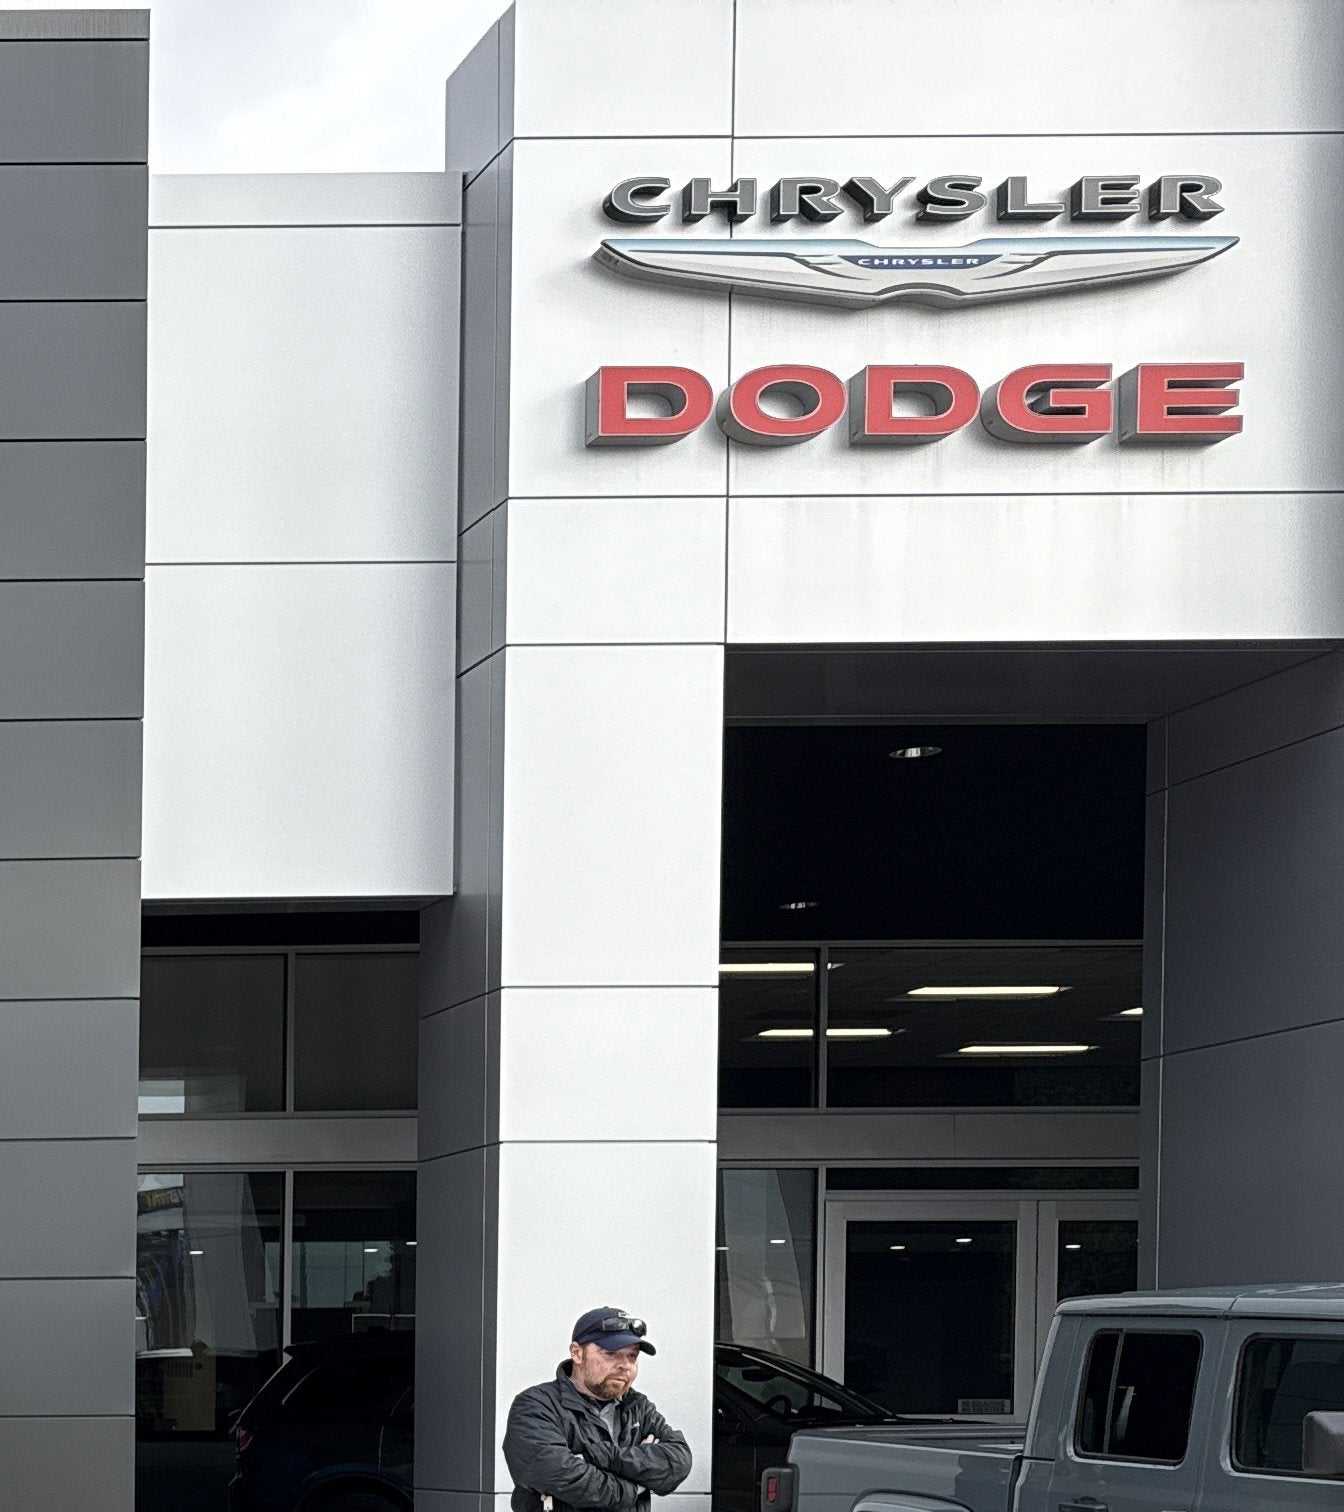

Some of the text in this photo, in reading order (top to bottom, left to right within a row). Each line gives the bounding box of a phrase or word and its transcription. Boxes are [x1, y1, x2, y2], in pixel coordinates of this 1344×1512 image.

[602, 175, 1225, 222] CHRYSLER
[857, 257, 981, 267] CHRYSLER
[586, 363, 1244, 446] DODGE
